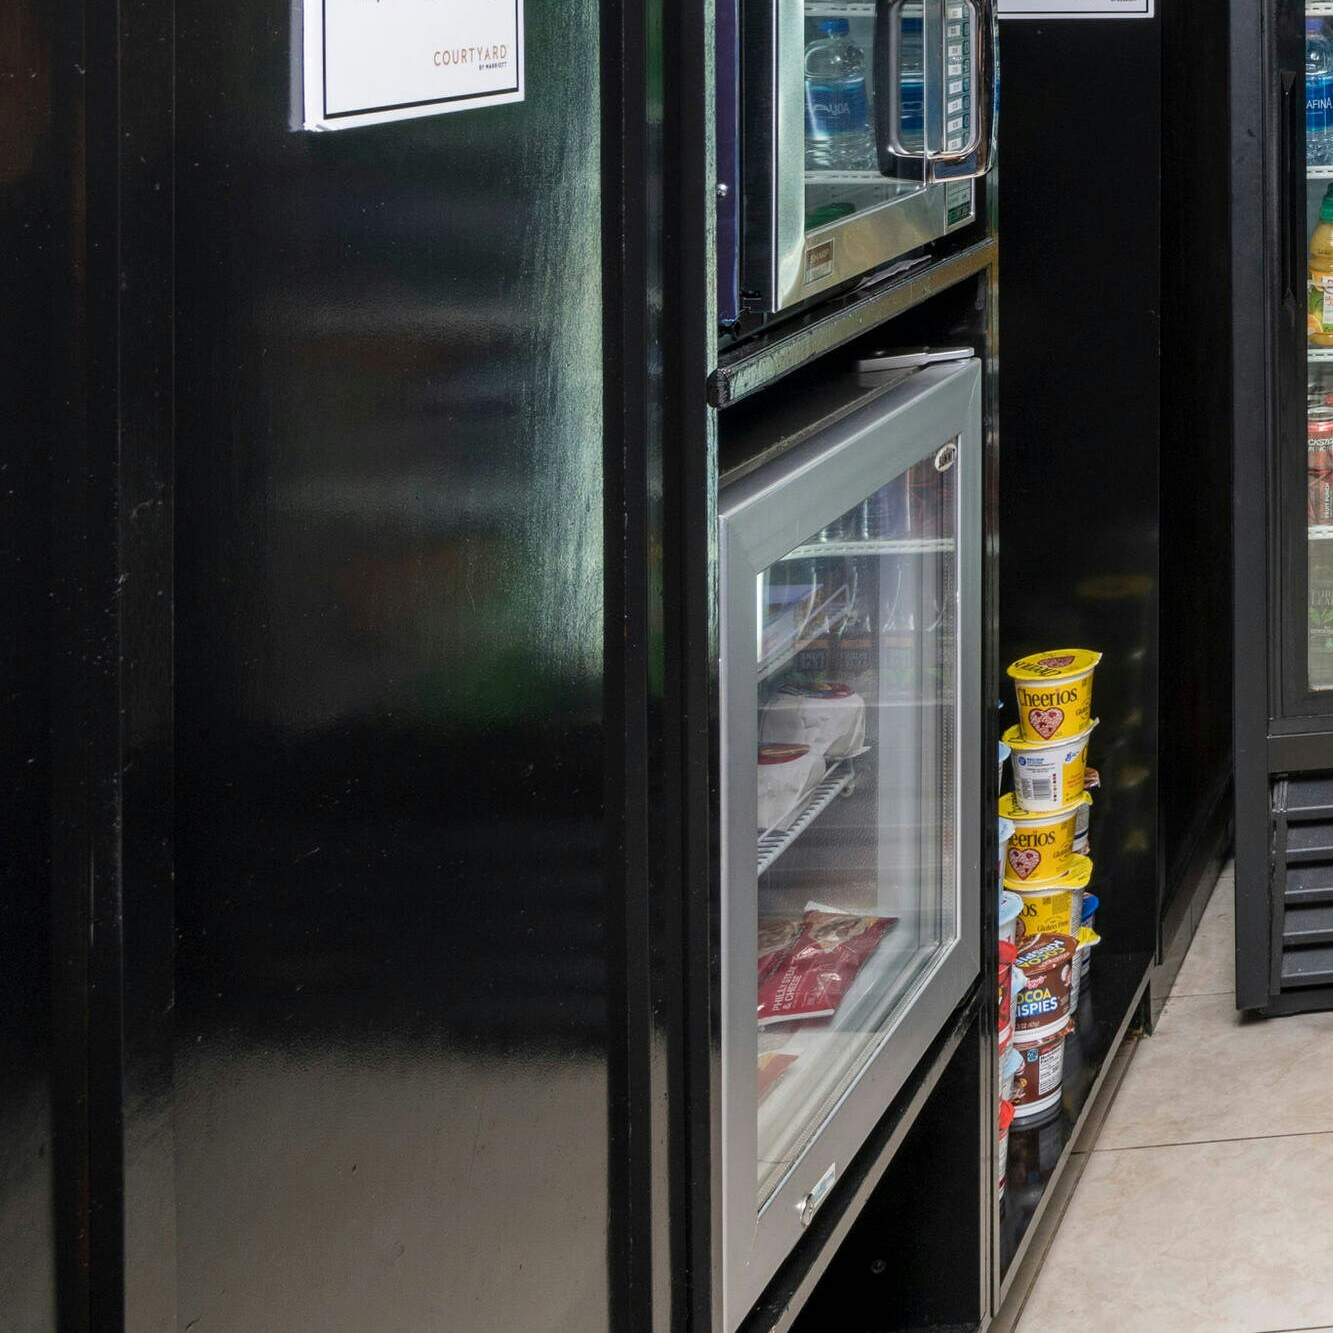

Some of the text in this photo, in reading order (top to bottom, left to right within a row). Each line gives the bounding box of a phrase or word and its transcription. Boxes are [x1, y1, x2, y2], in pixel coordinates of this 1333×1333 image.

[433, 44, 508, 67] COURTYARD
[1306, 97, 1333, 109] AFINA
[1008, 830, 1056, 847] eerios
[1016, 997, 1058, 1017] ISPIES
